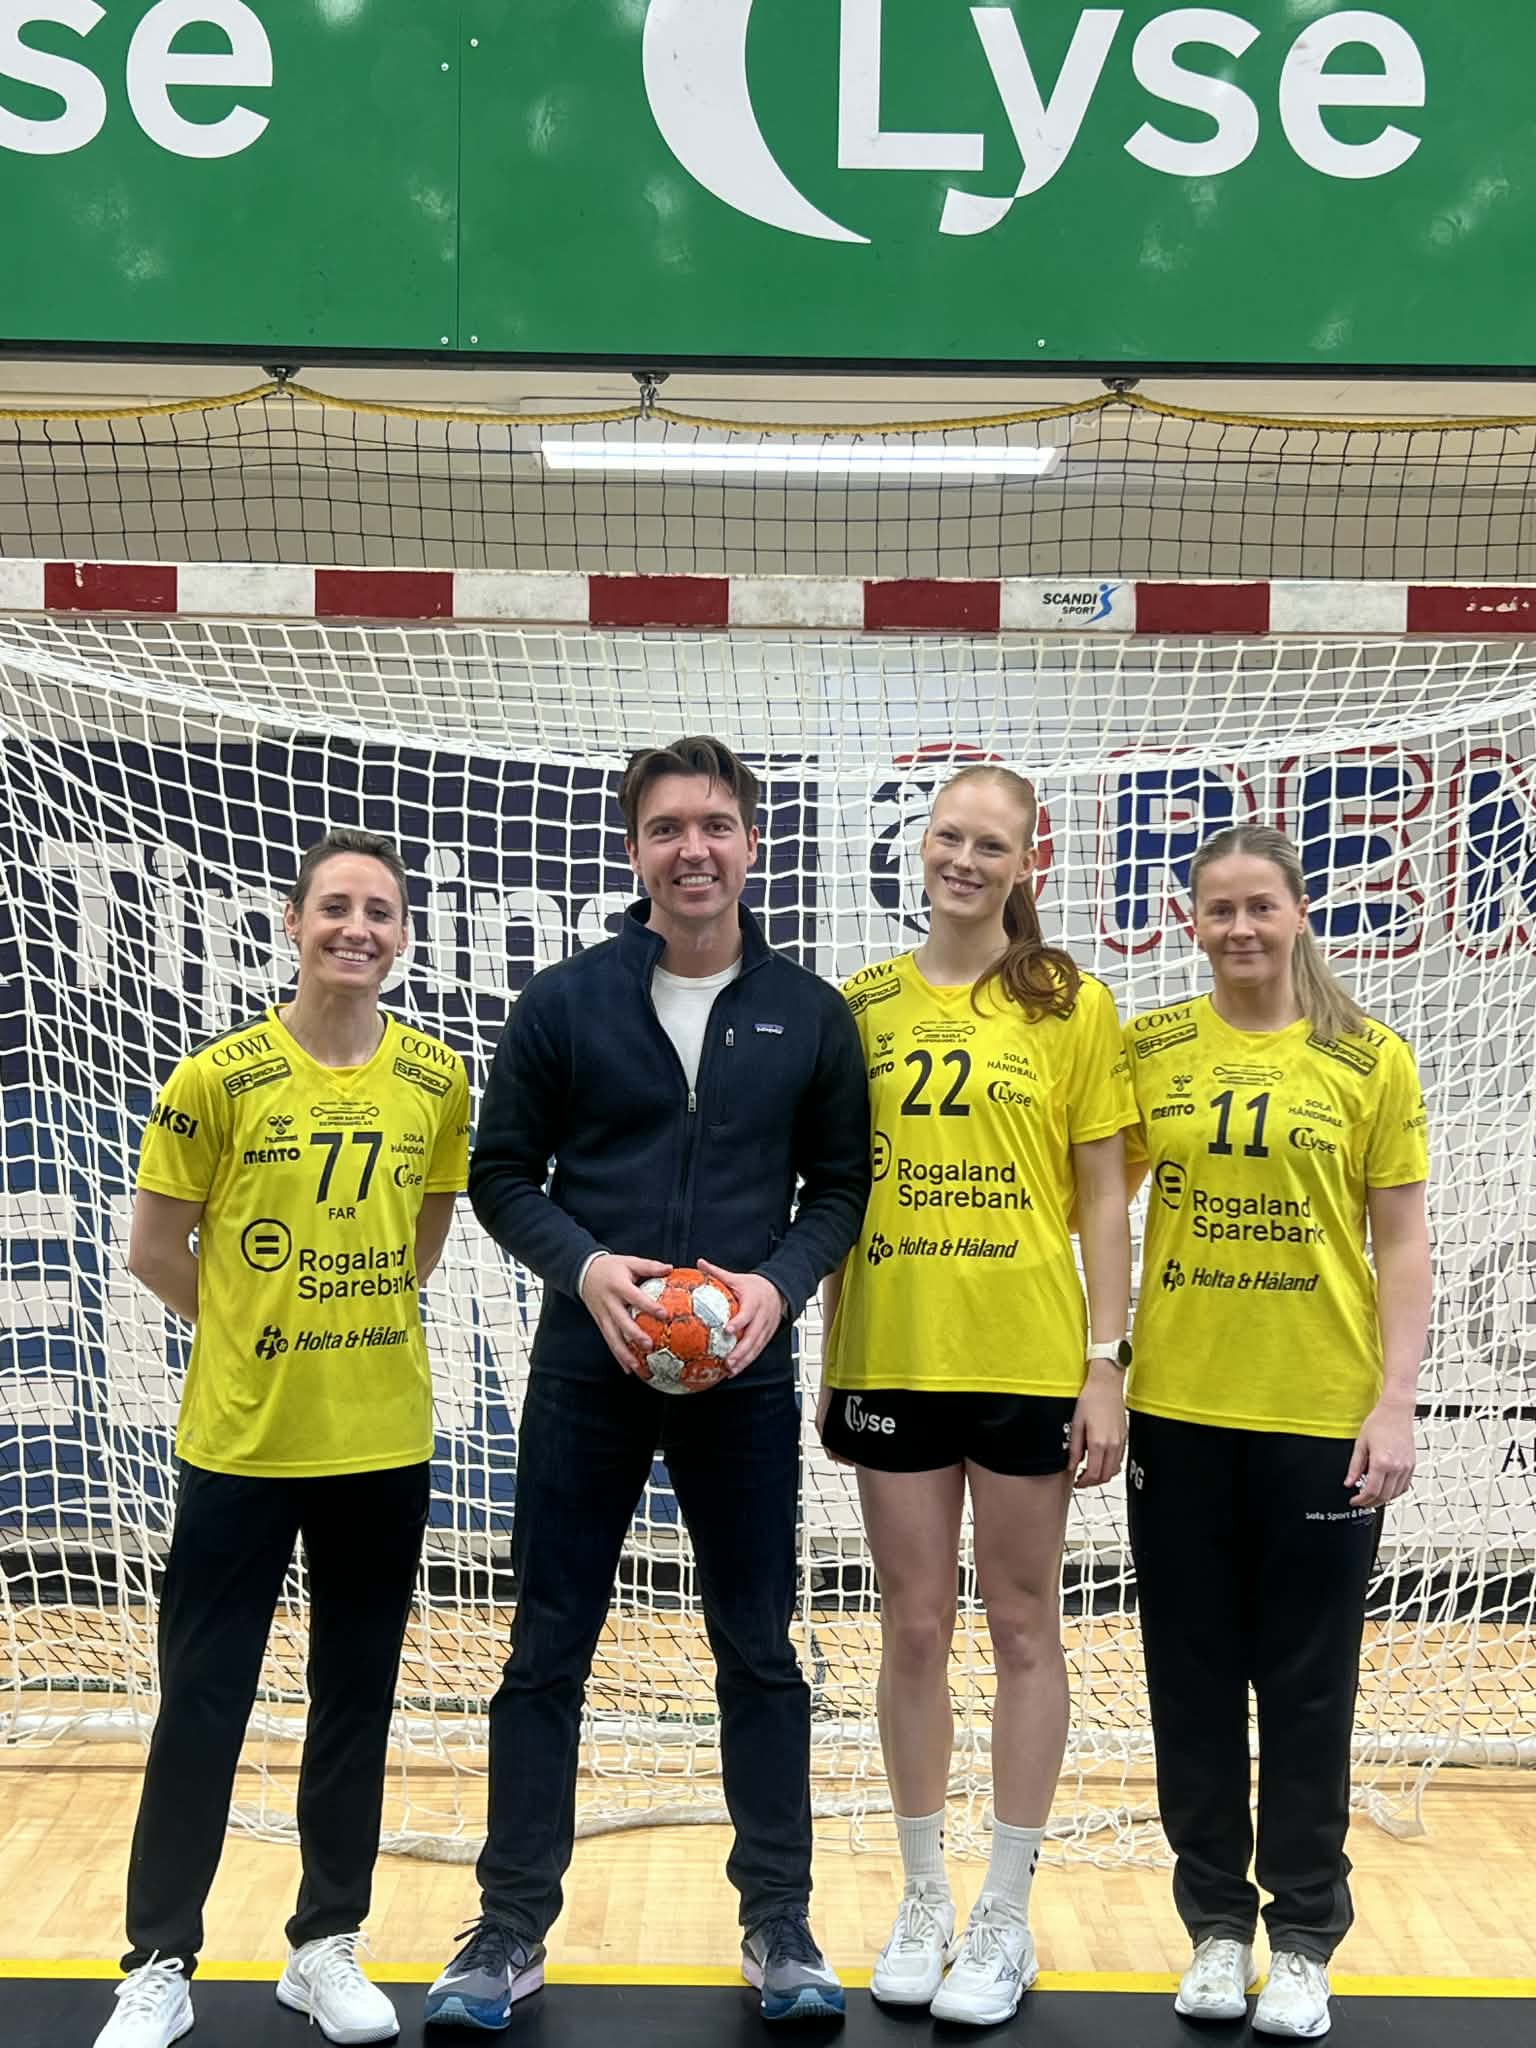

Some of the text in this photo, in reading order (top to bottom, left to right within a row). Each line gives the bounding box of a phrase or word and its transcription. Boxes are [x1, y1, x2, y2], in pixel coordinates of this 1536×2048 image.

[837, 0, 1426, 236] Lyse
[1042, 593, 1098, 605] SCANDI
[1061, 606, 1096, 615] SPORT
[1135, 1007, 1191, 1032] COWI
[212, 1033, 274, 1067] COWI
[401, 1036, 456, 1071] COWI
[1003, 1053, 1029, 1066] SOLA
[869, 1062, 894, 1079] ENTO
[901, 1049, 971, 1115] 22
[997, 1085, 1032, 1107] Lyse
[1151, 1104, 1195, 1120] MENTO
[1208, 1090, 1270, 1158] 11
[1299, 1131, 1336, 1154] Lyse
[244, 1148, 300, 1164] MENTO
[310, 1132, 383, 1203] 77
[898, 1158, 1016, 1185] Rogaland
[898, 1184, 1034, 1211] Sparebank
[1192, 1189, 1311, 1219] Rogaland
[328, 1207, 356, 1219] FAR
[1192, 1215, 1327, 1246] Sparebank
[898, 1236, 1019, 1258] Holta & Håland
[1191, 1267, 1320, 1292] Holta & Håland
[294, 1326, 408, 1351] Holta & Hålan
[852, 1403, 896, 1434] Lyse
[1129, 1459, 1145, 1490] PG
